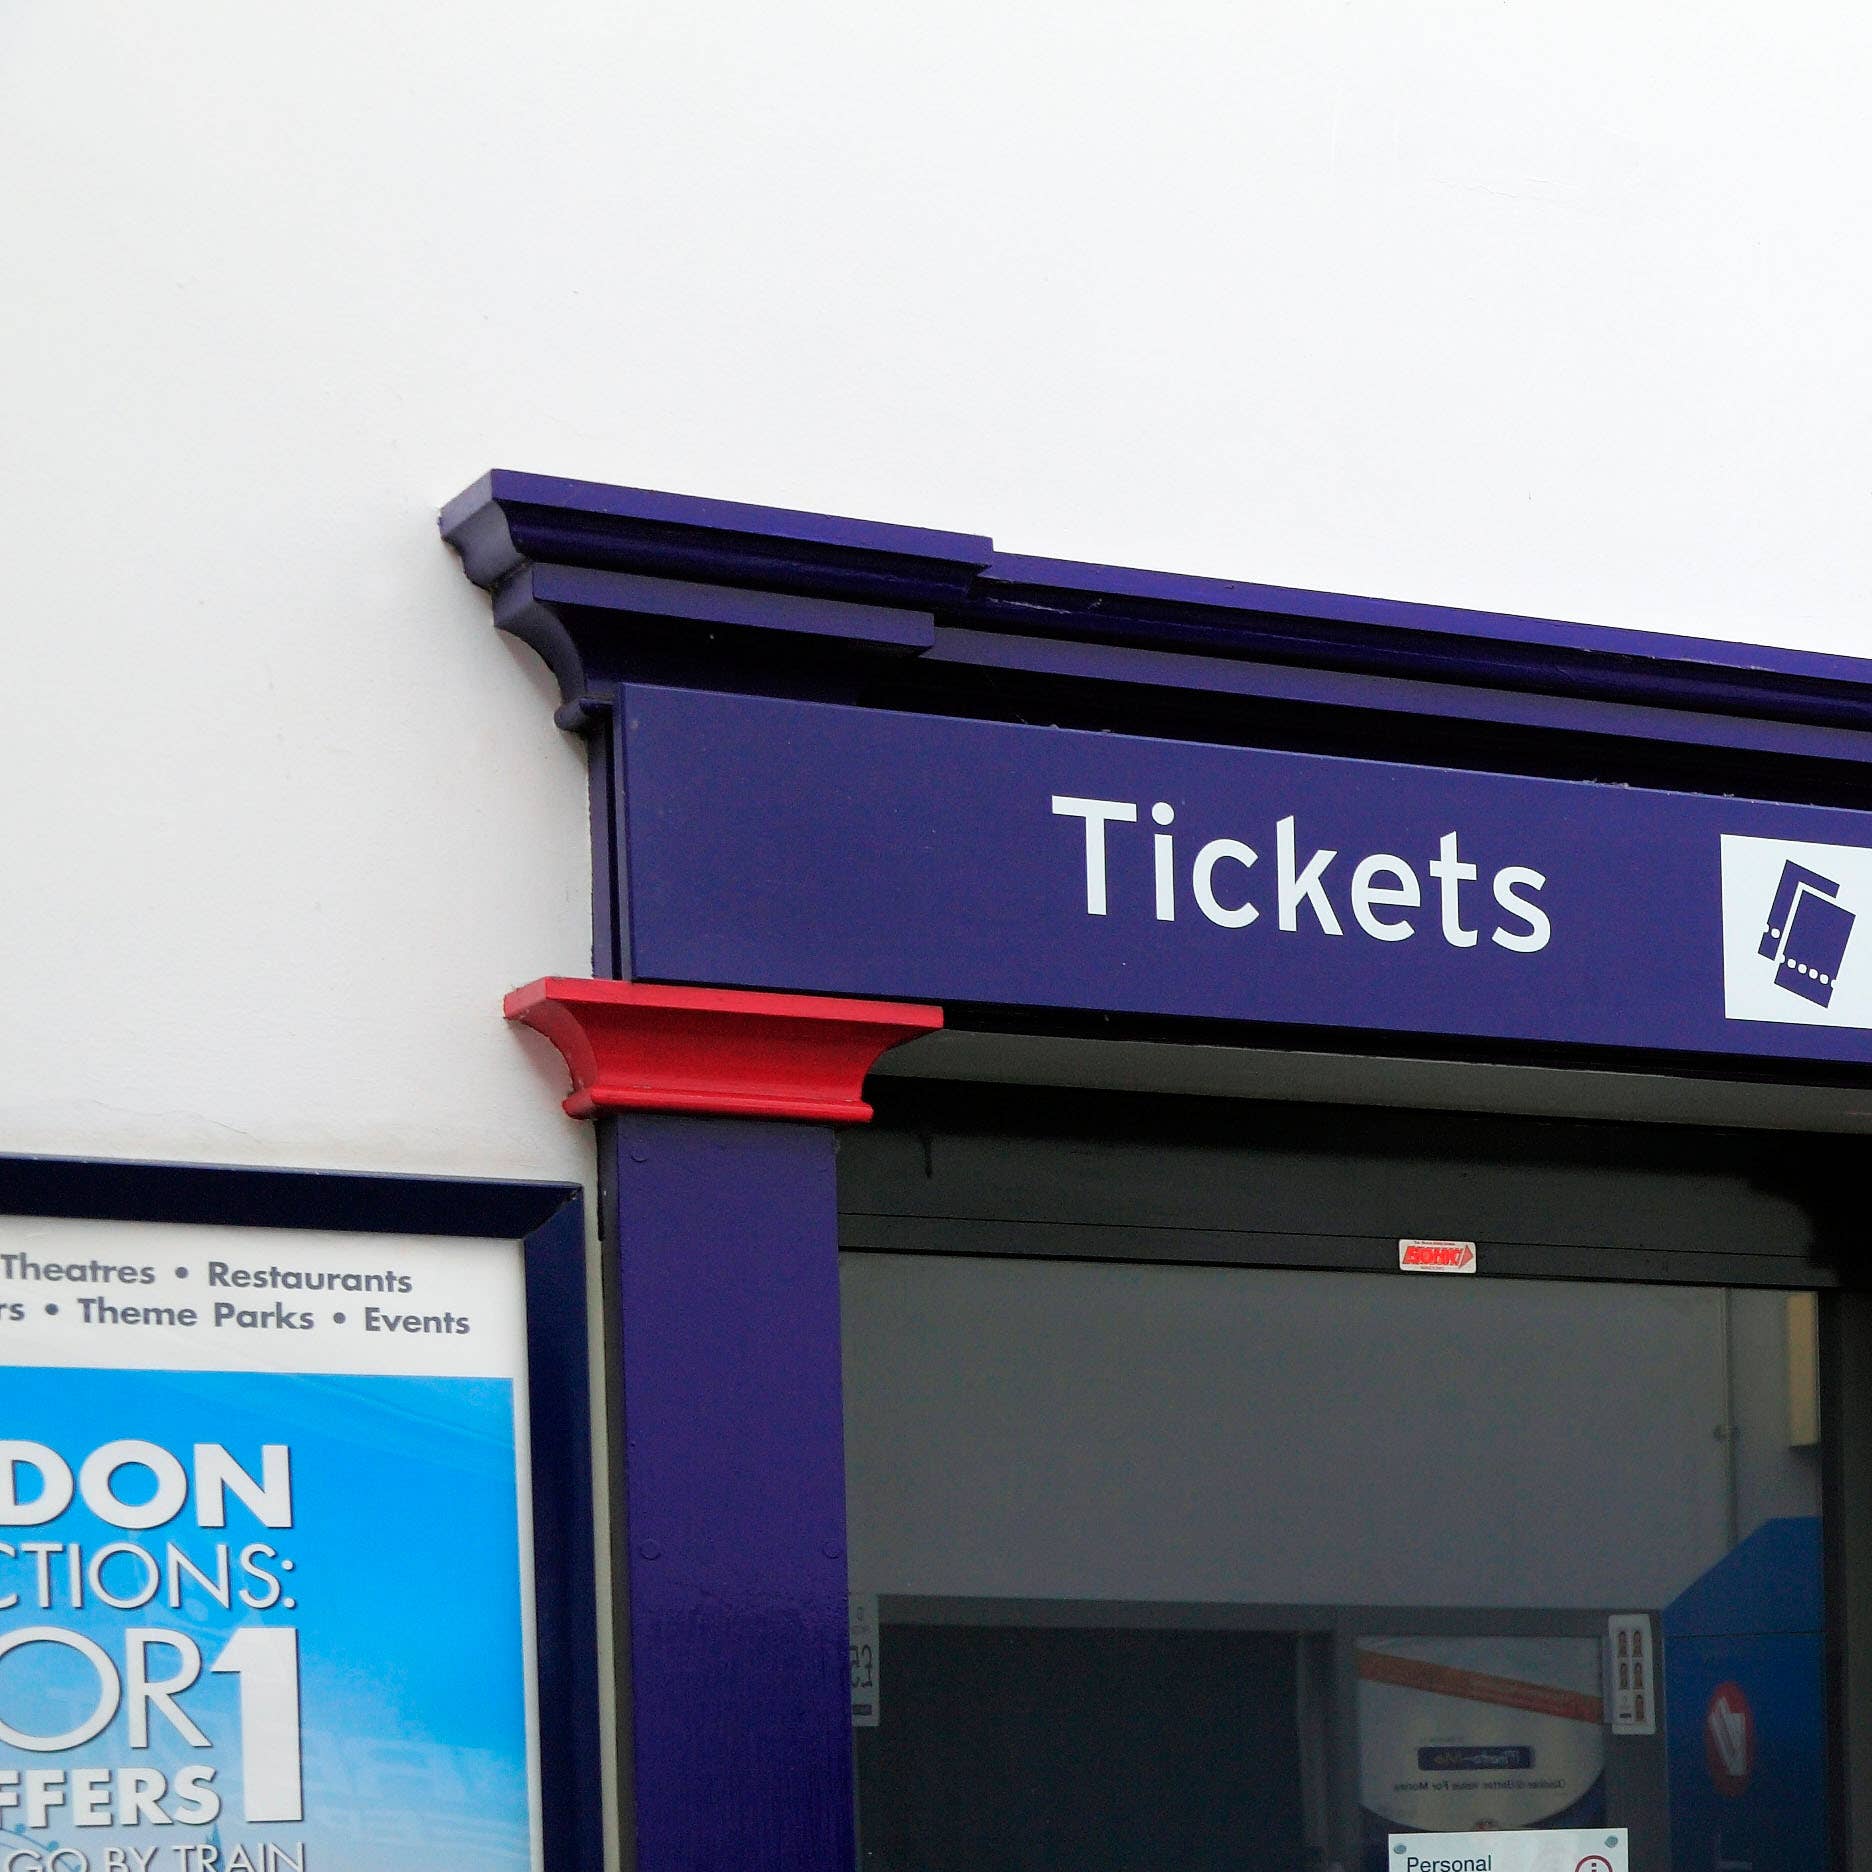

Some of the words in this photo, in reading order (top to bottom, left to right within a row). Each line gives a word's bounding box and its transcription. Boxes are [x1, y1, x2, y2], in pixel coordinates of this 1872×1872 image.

[1051, 794, 1552, 955] Tickets
[0, 1253, 155, 1285] Theatres
[209, 1261, 413, 1294] Restaurants
[77, 1297, 197, 1327] Theme
[214, 1302, 314, 1331] Parks
[365, 1307, 470, 1335] Events
[0, 1438, 294, 1530] DON
